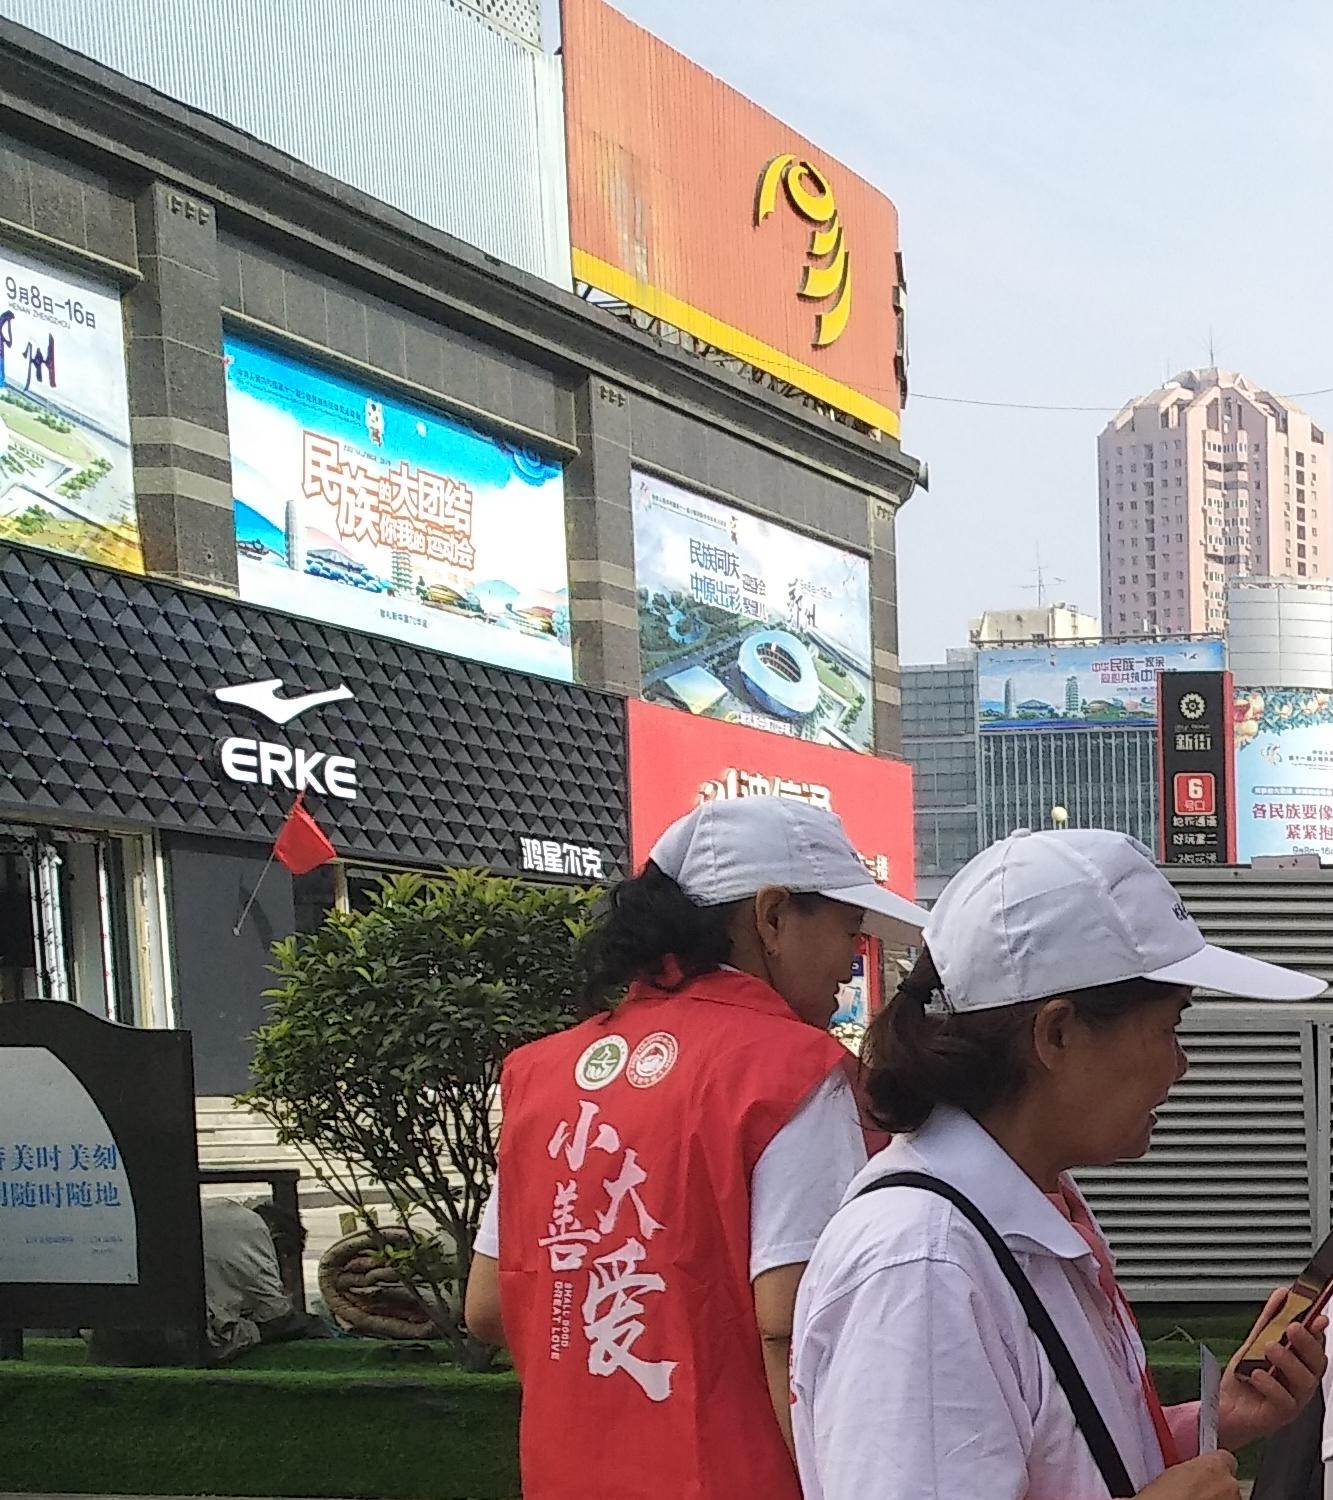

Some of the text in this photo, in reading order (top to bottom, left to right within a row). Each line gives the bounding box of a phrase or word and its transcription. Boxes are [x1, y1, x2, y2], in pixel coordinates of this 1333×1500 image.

[221, 736, 357, 799] ERKE
[1187, 777, 1203, 799] 6
[519, 836, 602, 878] 鸿星尔克
[0, 1143, 118, 1171] 美时美刻
